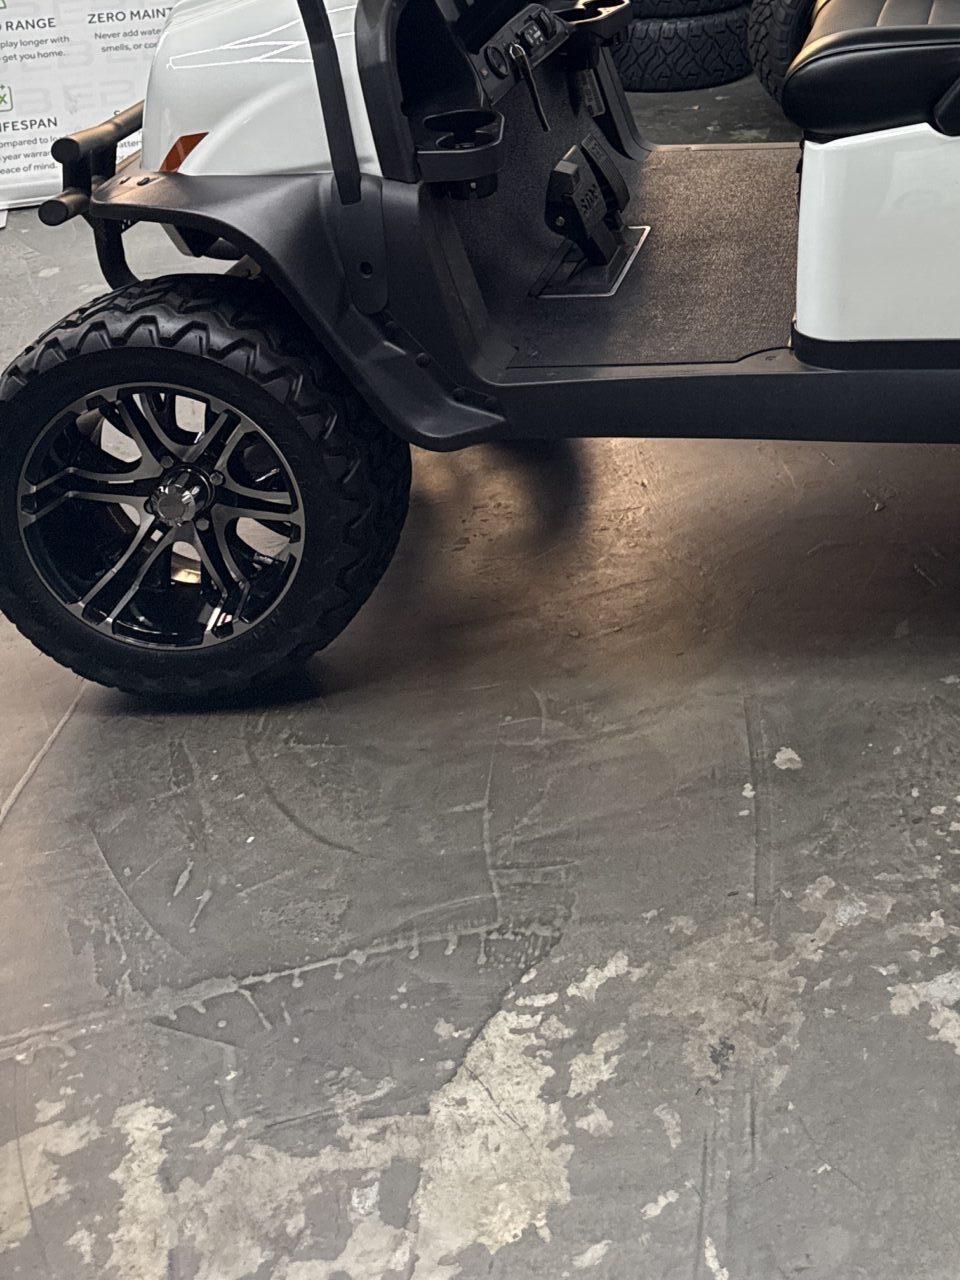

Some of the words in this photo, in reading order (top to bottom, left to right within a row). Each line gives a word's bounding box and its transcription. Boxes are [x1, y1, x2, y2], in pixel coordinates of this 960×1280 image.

[87, 11, 126, 24] ZERO
[5, 17, 56, 31] RANGE
[94, 31, 121, 39] Never
[122, 29, 139, 37] add
[140, 27, 161, 36] wate
[0, 40, 18, 50] play
[20, 38, 49, 48] longer
[50, 35, 70, 44] with
[101, 43, 132, 52] smells,
[2, 53, 17, 63] get
[19, 53, 36, 62] you
[39, 136, 49, 144] to
[2, 153, 21, 163] year
[22, 163, 32, 172] of
